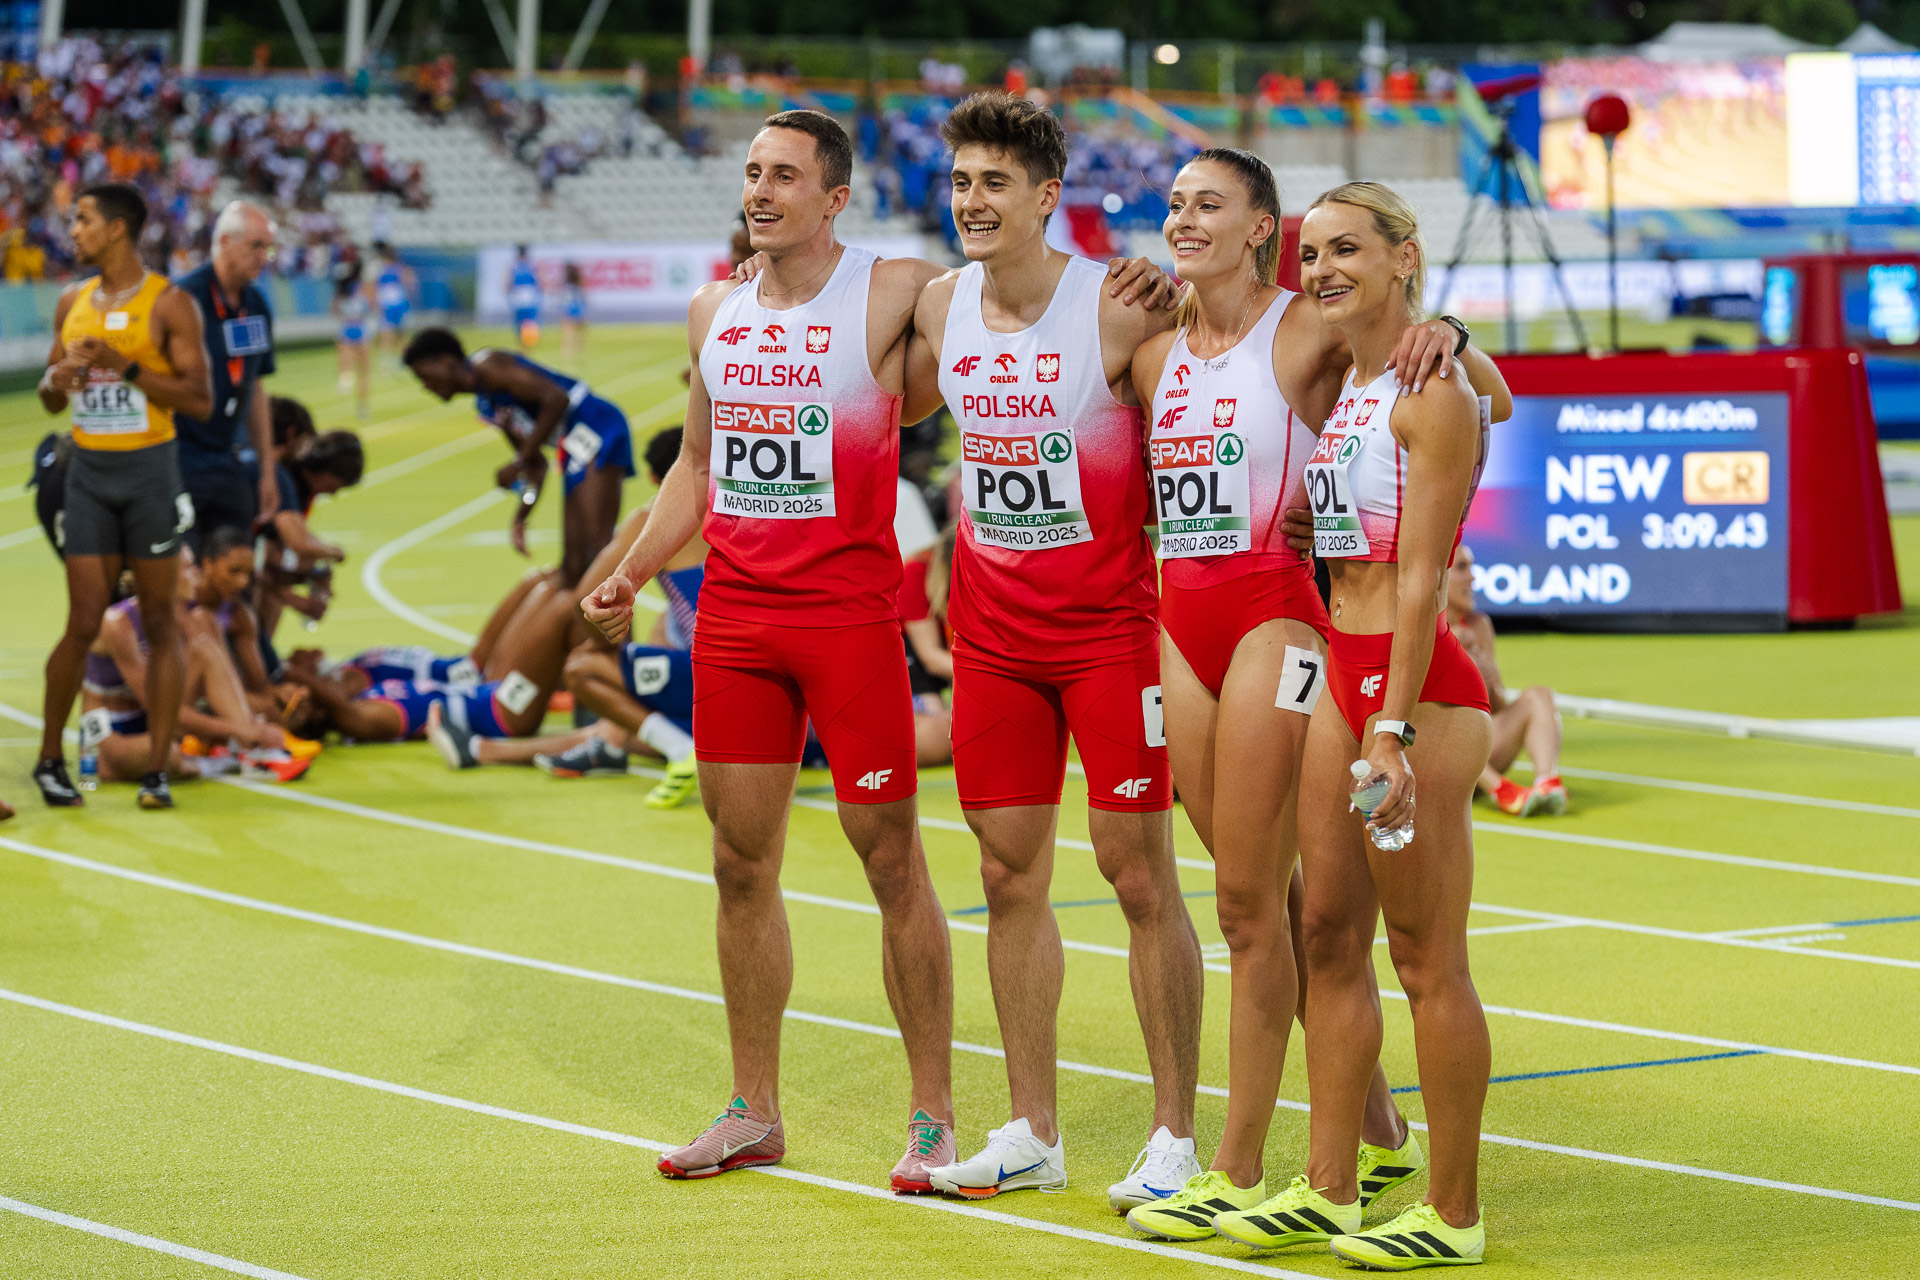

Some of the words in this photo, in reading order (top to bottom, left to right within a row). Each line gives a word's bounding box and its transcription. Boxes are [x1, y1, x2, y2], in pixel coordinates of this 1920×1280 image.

[758, 345, 787, 353] ORLEN
[723, 363, 822, 388] POLSKA
[989, 375, 1018, 383] ORLEN
[1165, 388, 1189, 399] ORLEN
[716, 404, 792, 430] SPAR
[963, 394, 1056, 418] POLSKA
[1556, 401, 1645, 433] Mixed
[725, 436, 816, 481] POL
[964, 436, 1036, 463] SPAR
[1311, 436, 1343, 460] PAR
[738, 482, 759, 493] RUN
[976, 467, 1067, 512] POL
[1546, 453, 1671, 504] NEW
[1697, 458, 1755, 498] CR
[723, 493, 779, 513] MADRID
[783, 498, 823, 514] 2025
[1157, 471, 1232, 518] POL
[991, 514, 1013, 525] RUN
[1172, 521, 1184, 532] RUN
[1546, 514, 1619, 550] POL
[1641, 511, 1768, 549] 3:09.43
[980, 527, 1033, 545] MADRID
[1037, 525, 1079, 544] 2025
[1161, 537, 1198, 553] MADRID
[1199, 535, 1238, 550] 2025
[1328, 535, 1358, 551] 2025
[1295, 659, 1318, 704] 7
